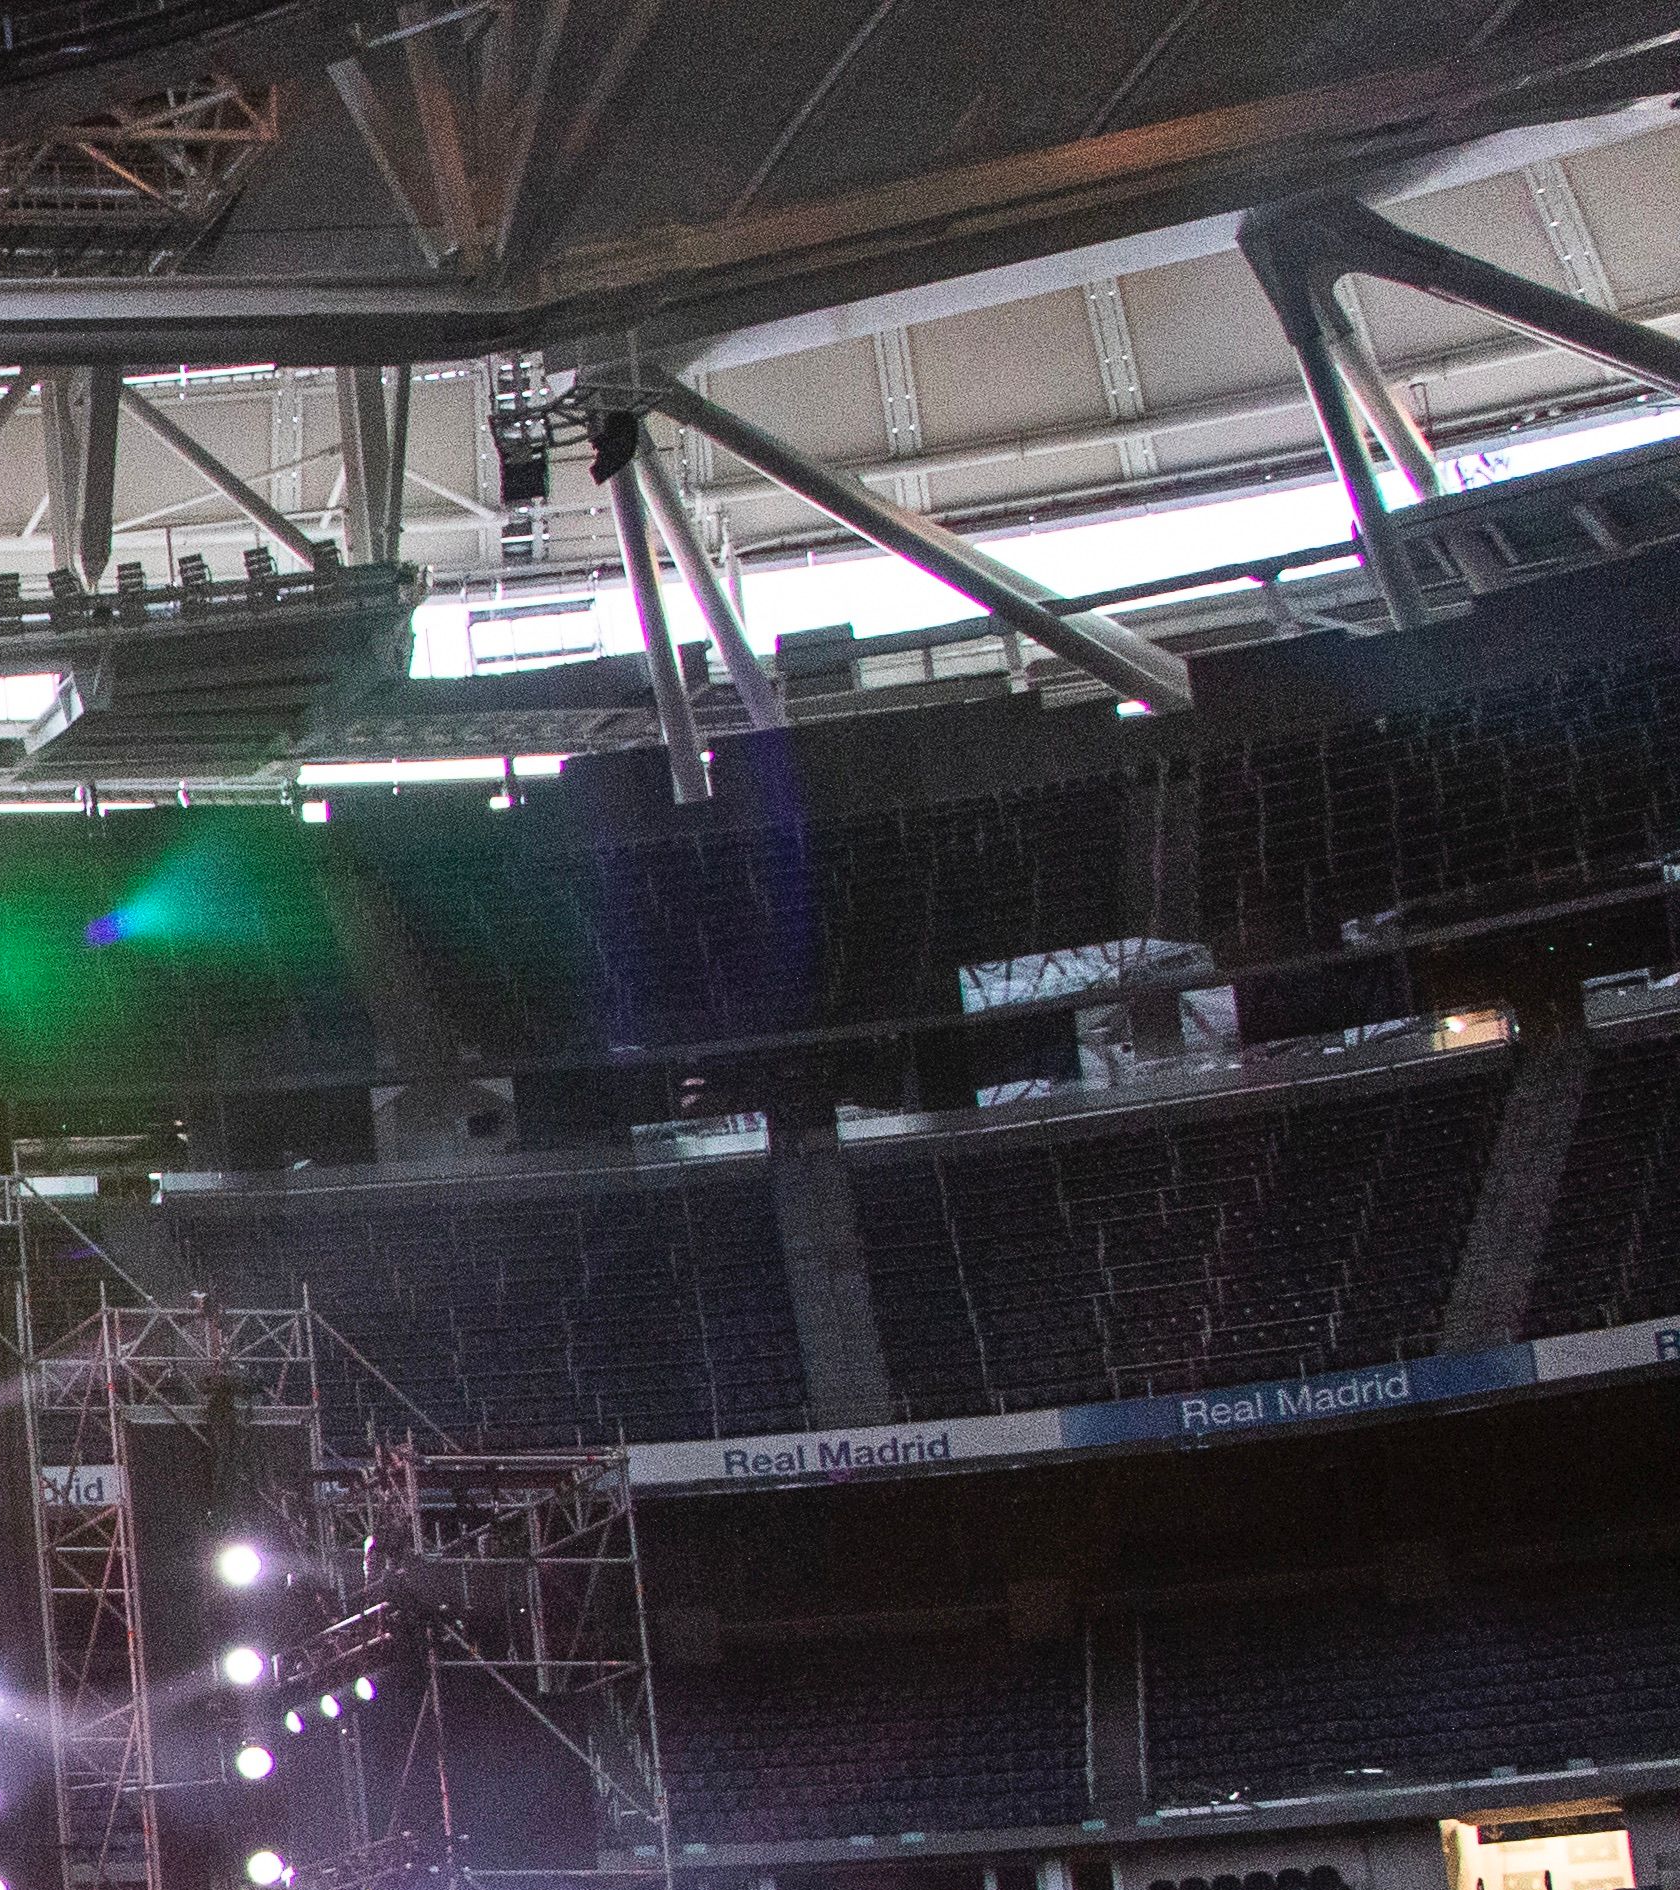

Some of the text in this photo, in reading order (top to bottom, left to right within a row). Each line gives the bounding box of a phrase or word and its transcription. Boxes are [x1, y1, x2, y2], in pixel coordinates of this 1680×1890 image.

[1181, 1369, 1410, 1429] Real Madrid
[722, 1432, 952, 1476] Real Madrid
